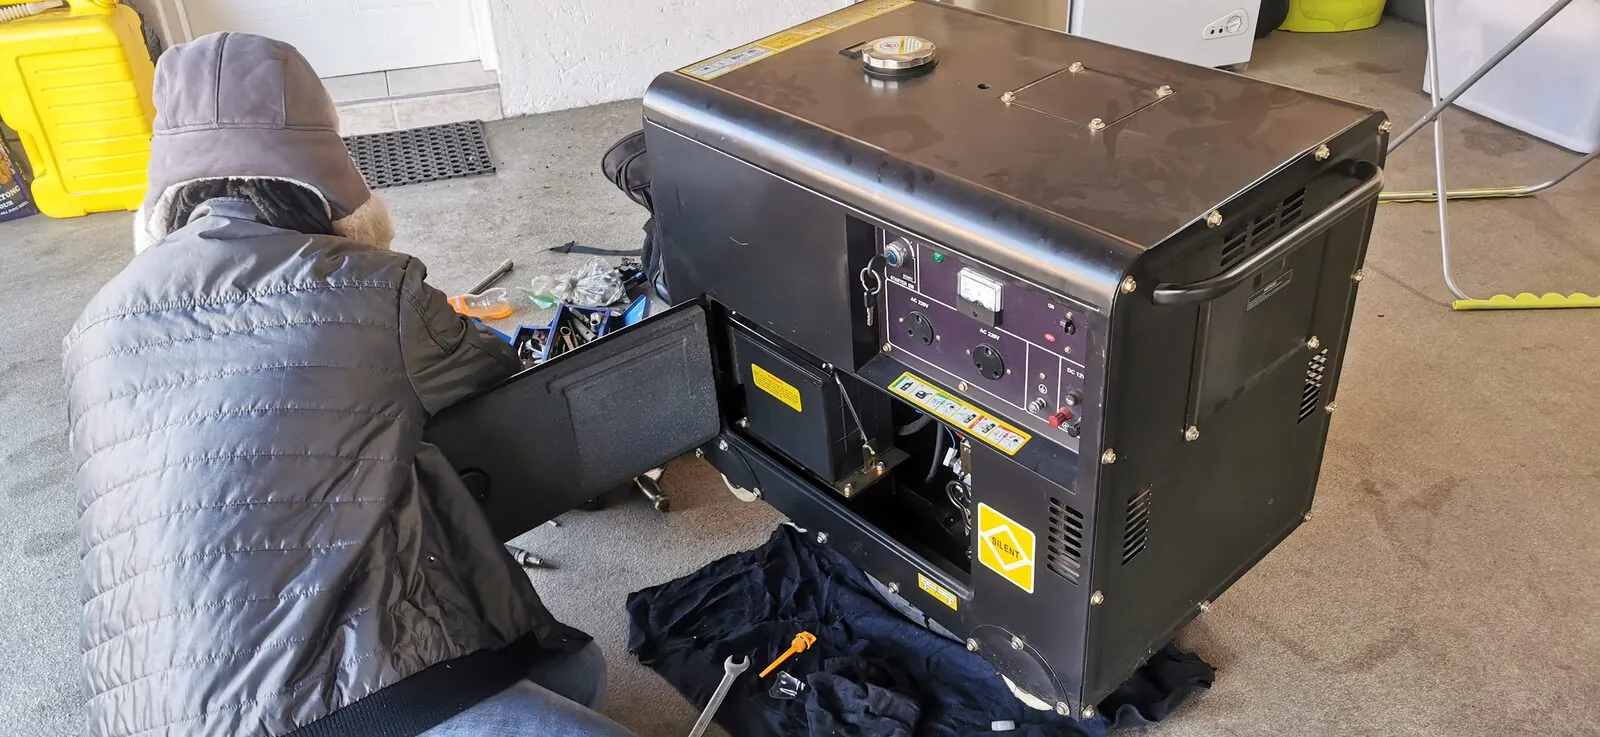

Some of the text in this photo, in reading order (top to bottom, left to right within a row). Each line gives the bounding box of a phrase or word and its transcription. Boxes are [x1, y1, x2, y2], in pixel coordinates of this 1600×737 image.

[918, 300, 929, 308] 220V
[987, 332, 1000, 340] 220V
[991, 536, 1020, 559] SILENT
